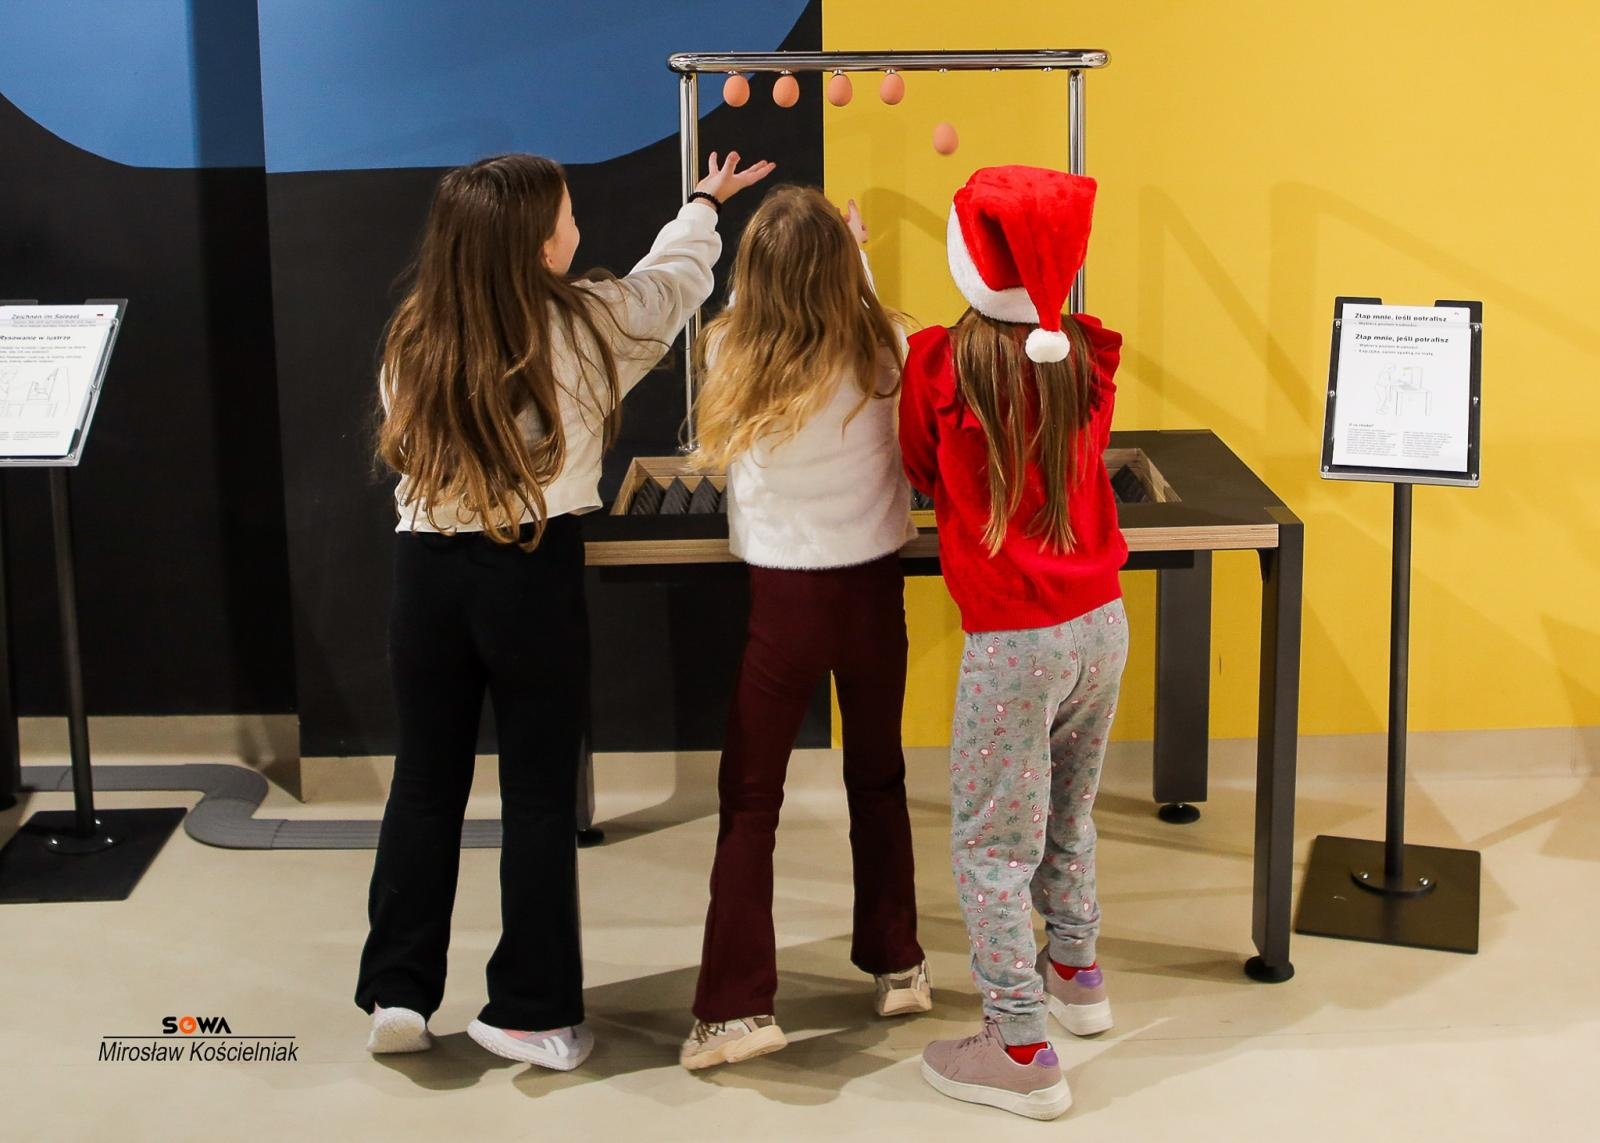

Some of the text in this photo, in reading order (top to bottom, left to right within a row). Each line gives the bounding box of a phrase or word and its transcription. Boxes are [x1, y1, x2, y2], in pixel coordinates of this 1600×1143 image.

[1355, 333, 1372, 342] Złap
[1396, 335, 1413, 343] jeśli
[1414, 336, 1449, 344] potrafisz
